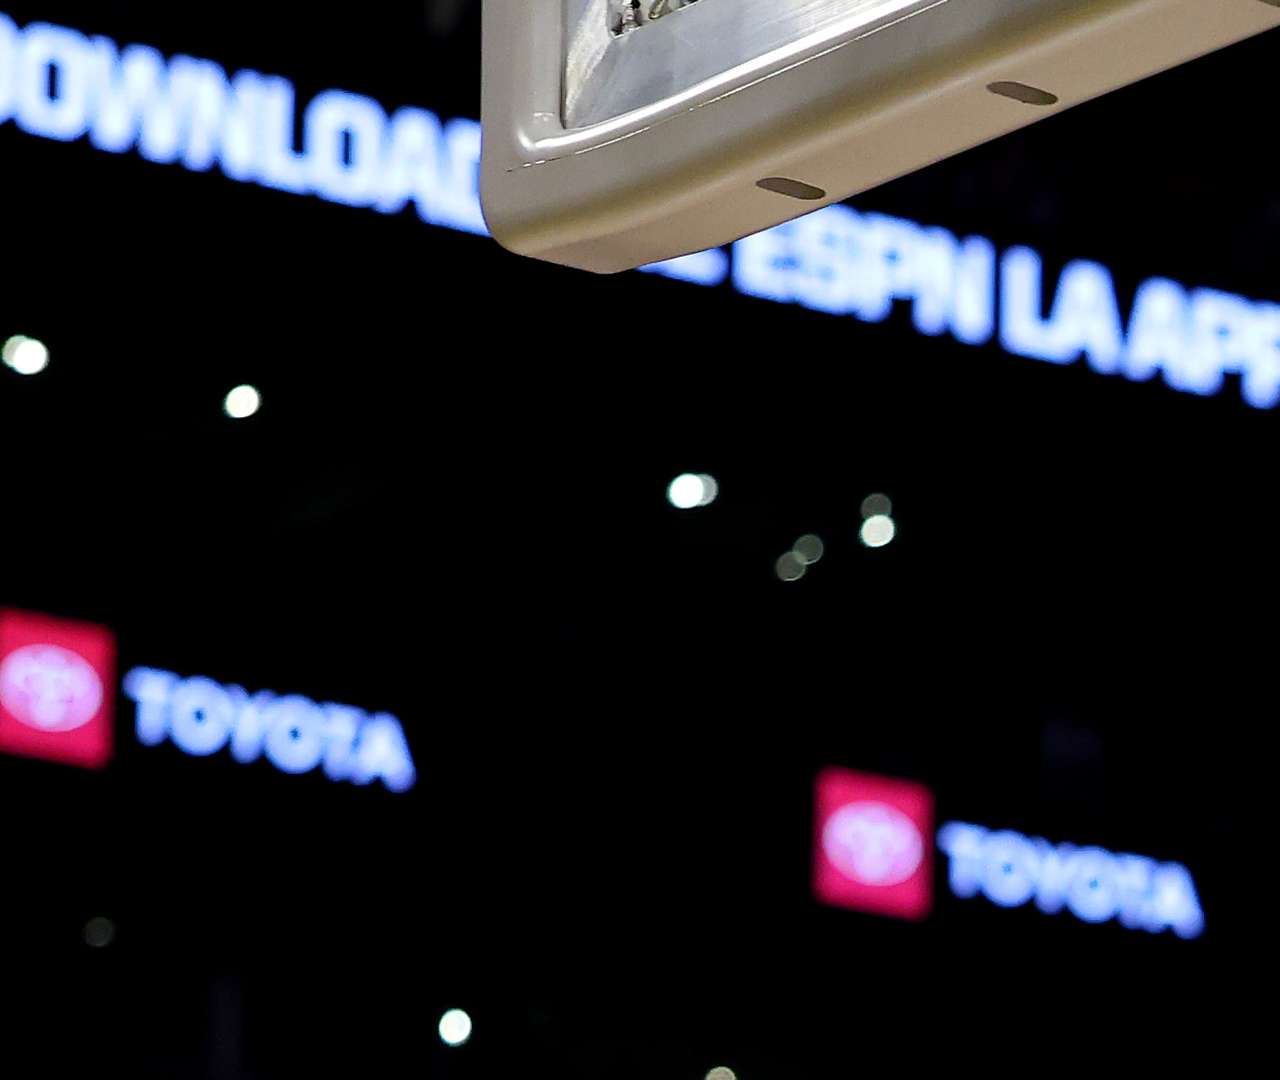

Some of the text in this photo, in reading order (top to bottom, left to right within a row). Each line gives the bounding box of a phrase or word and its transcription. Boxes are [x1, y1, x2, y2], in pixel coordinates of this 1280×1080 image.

[0, 10, 485, 238] OWNLOA
[122, 664, 416, 793] TOYOTA
[936, 820, 1205, 938] TOYOTA
